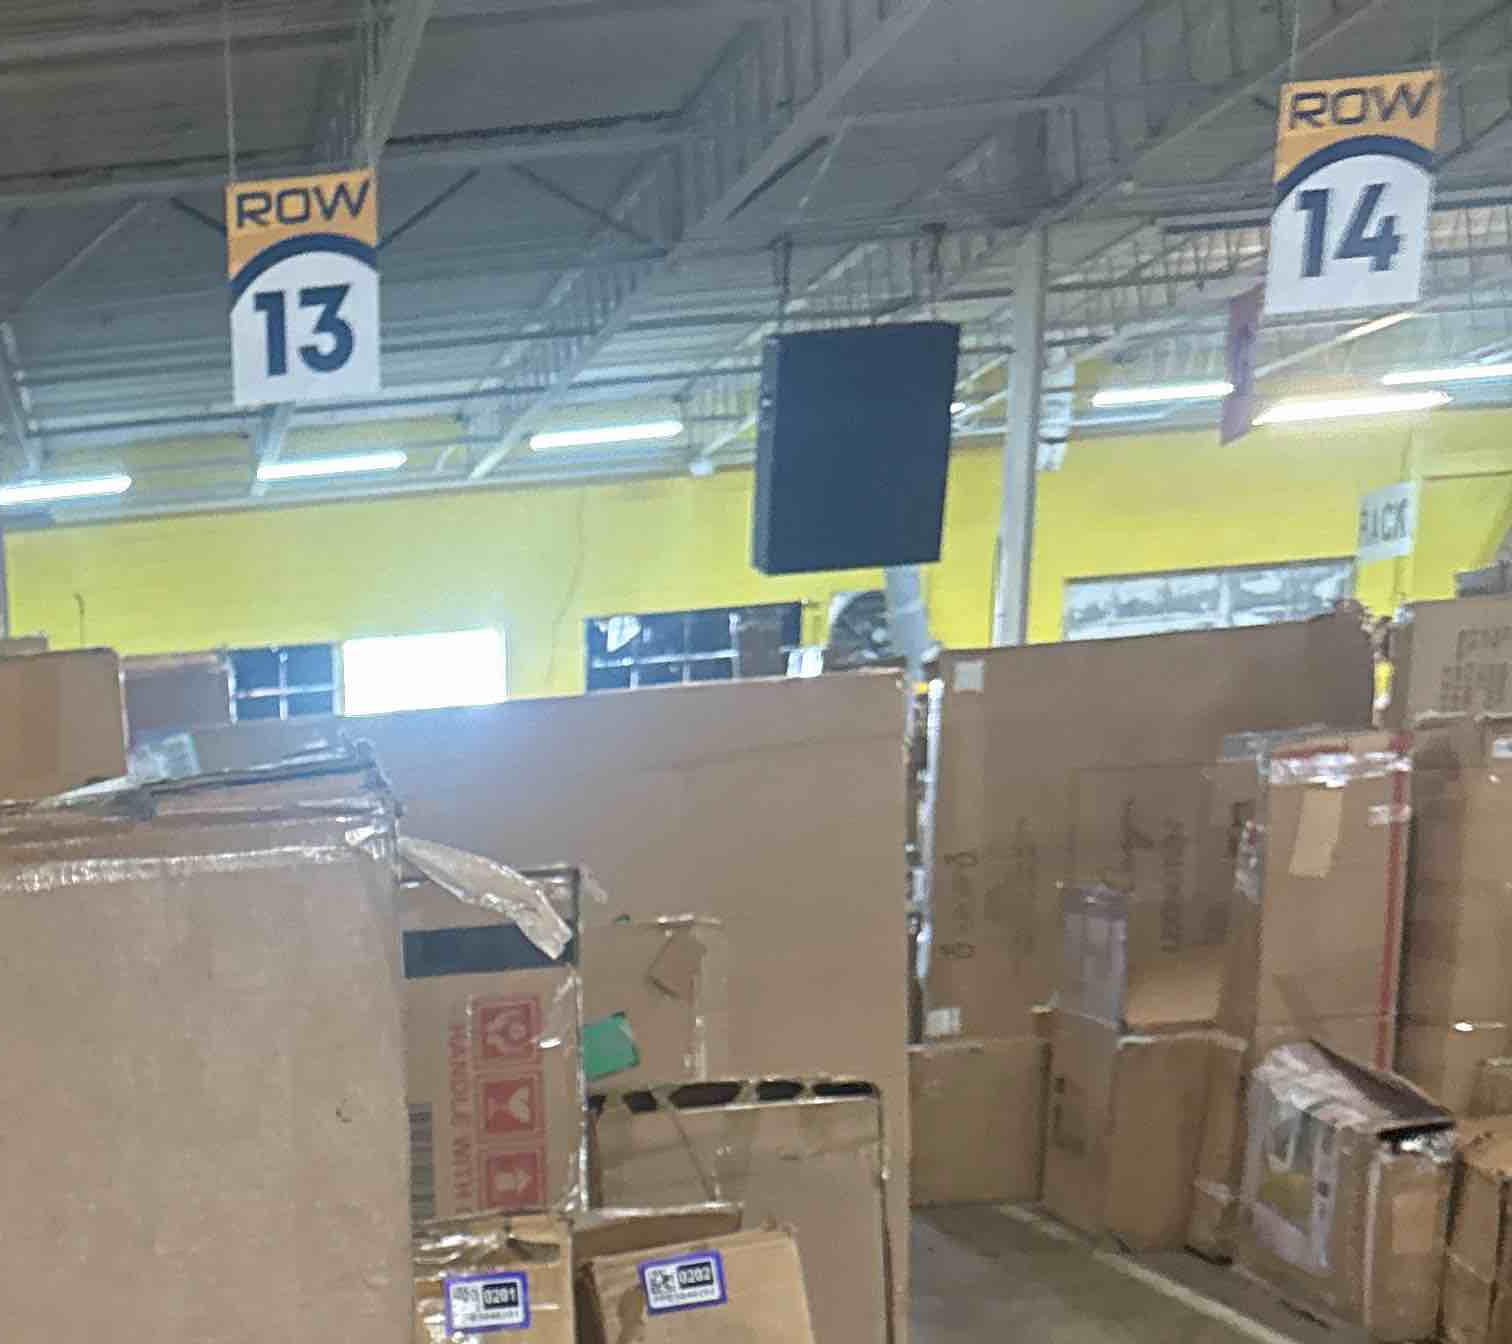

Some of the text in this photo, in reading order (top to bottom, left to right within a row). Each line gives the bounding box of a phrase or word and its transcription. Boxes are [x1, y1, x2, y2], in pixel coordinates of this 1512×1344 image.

[1289, 80, 1434, 130] ROW
[236, 179, 370, 229] ROW
[1295, 182, 1402, 277] 14
[252, 283, 355, 378] 13
[449, 1024, 472, 1127] HANDLE
[453, 1136, 473, 1198] WITH
